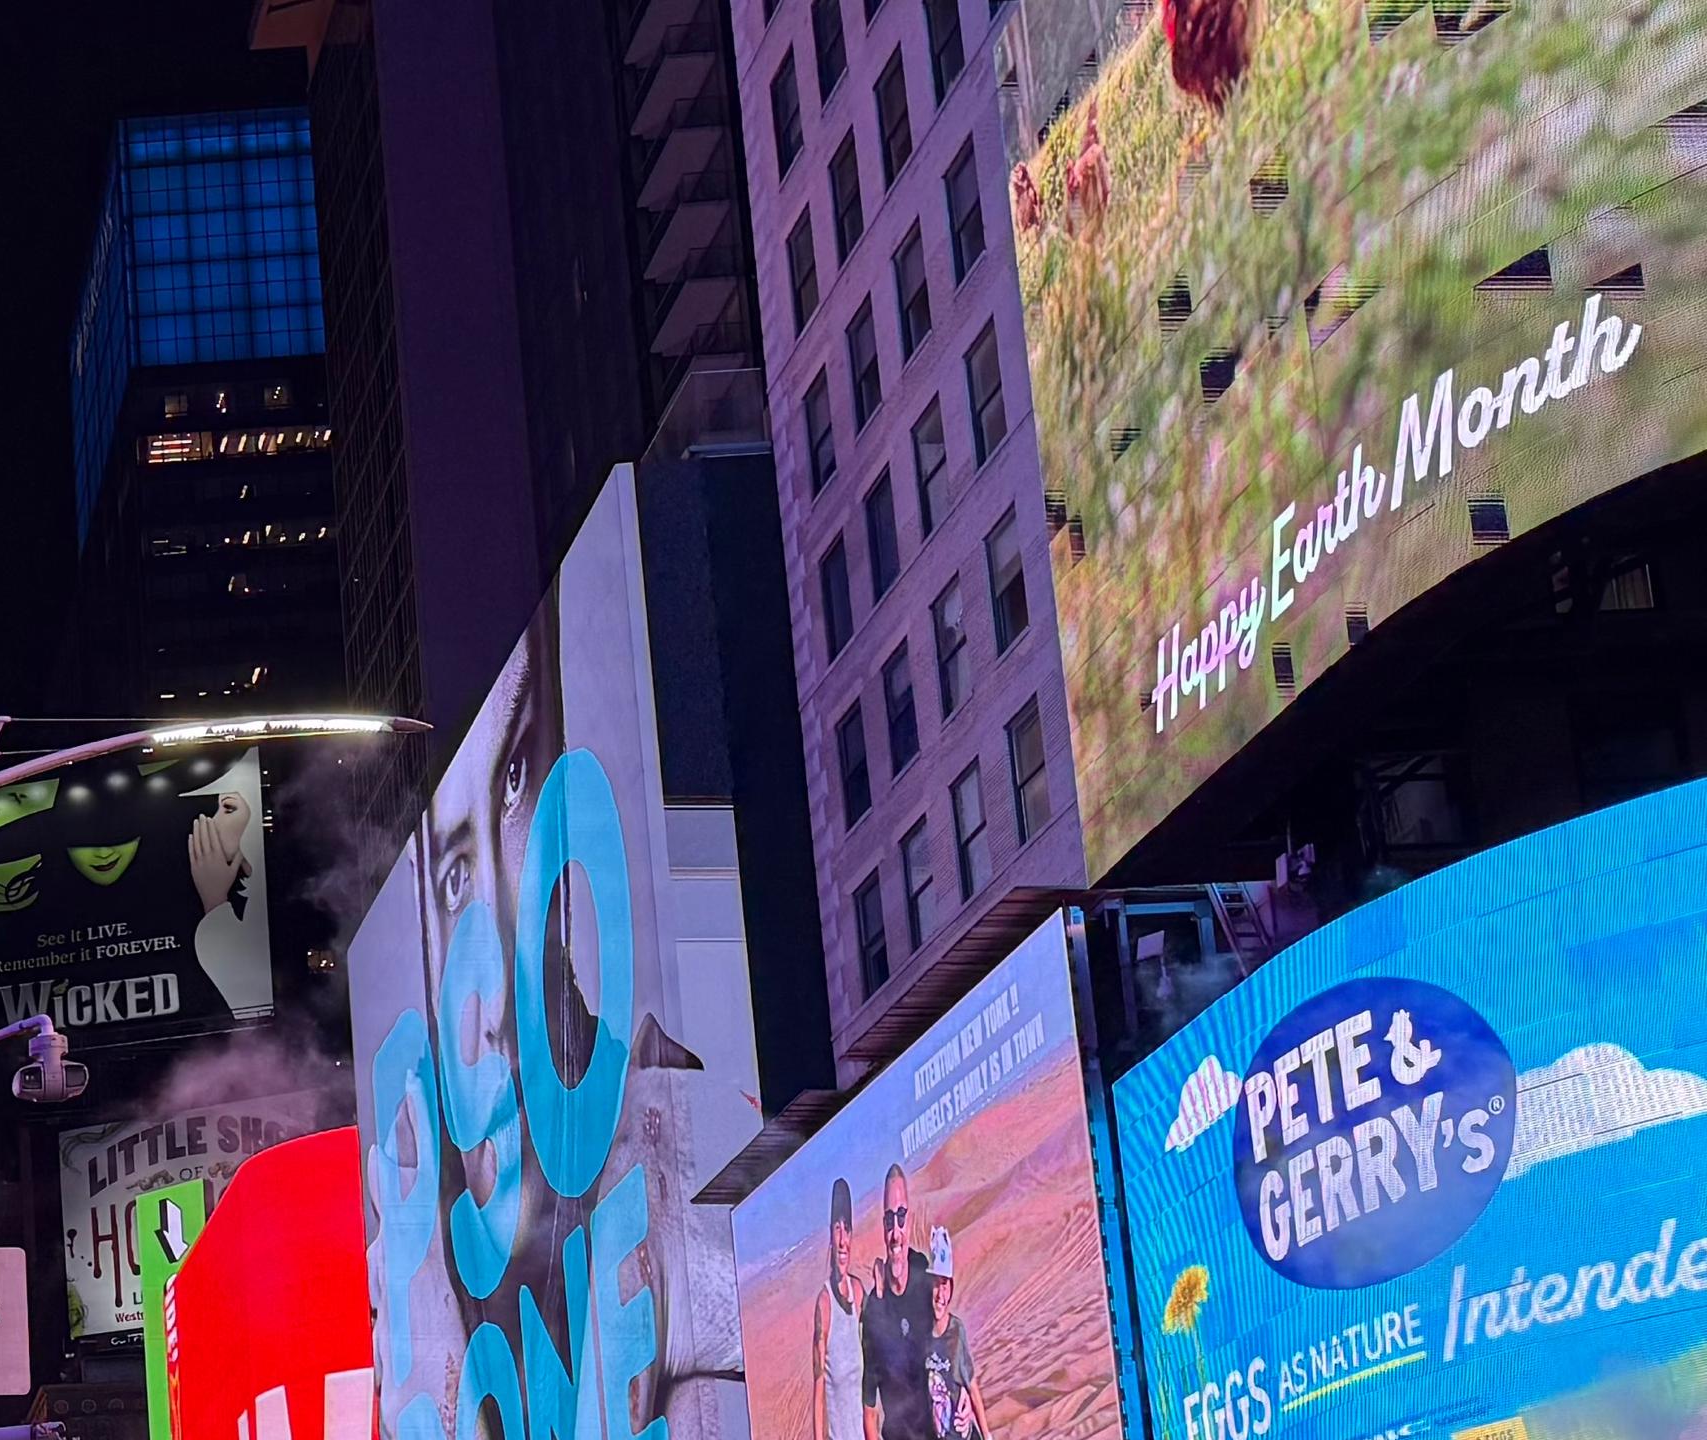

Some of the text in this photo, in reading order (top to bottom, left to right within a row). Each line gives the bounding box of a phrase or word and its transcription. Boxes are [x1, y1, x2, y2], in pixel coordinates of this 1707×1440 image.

[1150, 293, 1642, 733] Happy Earth Month
[37, 931, 65, 948] See
[86, 922, 133, 942] LIVE.
[96, 936, 181, 960] FOREVER.
[954, 1012, 1045, 1111] FAMILY IS IN TOWN
[961, 1031, 983, 1060] NEW
[985, 1002, 1011, 1039] YORK
[1245, 1008, 1442, 1163] PETE &
[87, 1113, 208, 1198] LITTLE
[178, 1166, 204, 1181] OF
[1279, 1358, 1309, 1400] AS
[1309, 1303, 1425, 1394] NATURE
